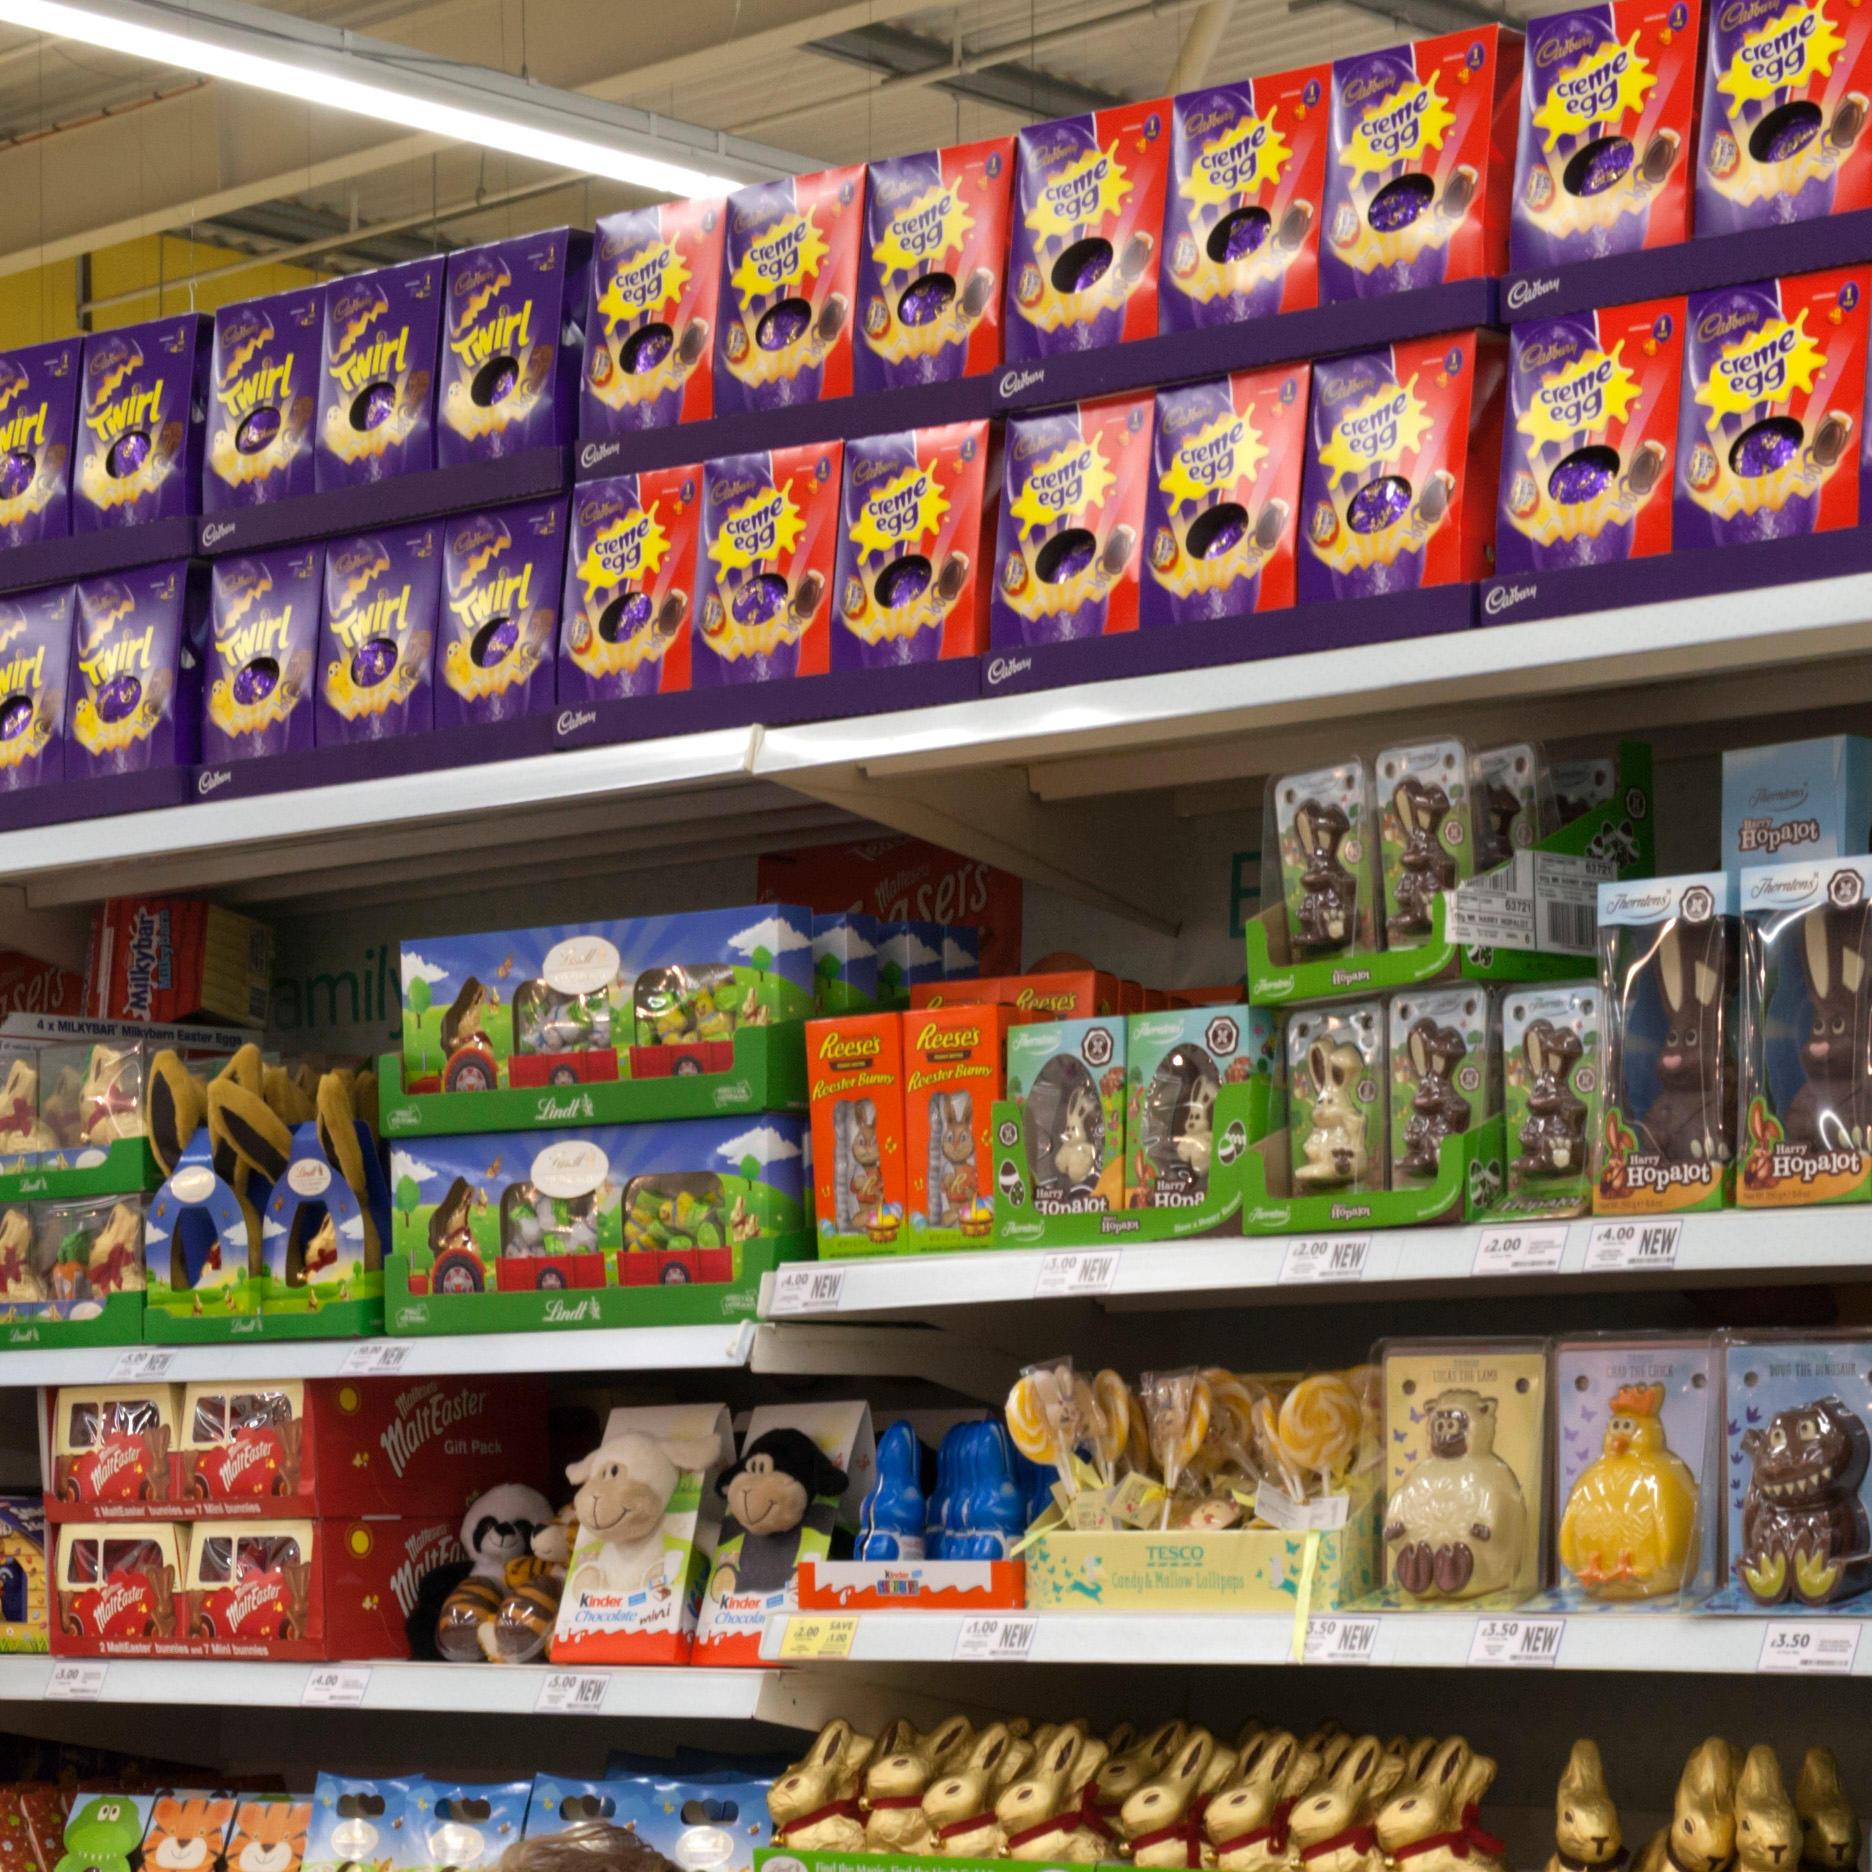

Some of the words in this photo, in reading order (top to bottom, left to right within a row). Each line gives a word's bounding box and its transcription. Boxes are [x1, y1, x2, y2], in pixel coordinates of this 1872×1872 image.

[1740, 15, 1817, 69] creme
[1750, 42, 1809, 84] egg
[330, 327, 408, 389] Twirl
[1179, 421, 1246, 466] creme
[1189, 451, 1237, 485] egg
[452, 561, 533, 623] Twirl
[37, 1020, 45, 1031] 4
[48, 1022, 54, 1031] x
[58, 1020, 116, 1037] MILKYBAR
[122, 1025, 174, 1039] Milkybarn
[177, 1029, 213, 1043] Easter
[216, 1031, 243, 1046] Eggs
[916, 1024, 980, 1050] Reese's
[908, 1065, 953, 1092] Reester
[955, 1062, 992, 1081] Bunny
[1771, 1147, 1860, 1181] Hopalot
[1774, 1142, 1808, 1158] Harry
[444, 1441, 467, 1455] Gift
[471, 1440, 503, 1455] Pack
